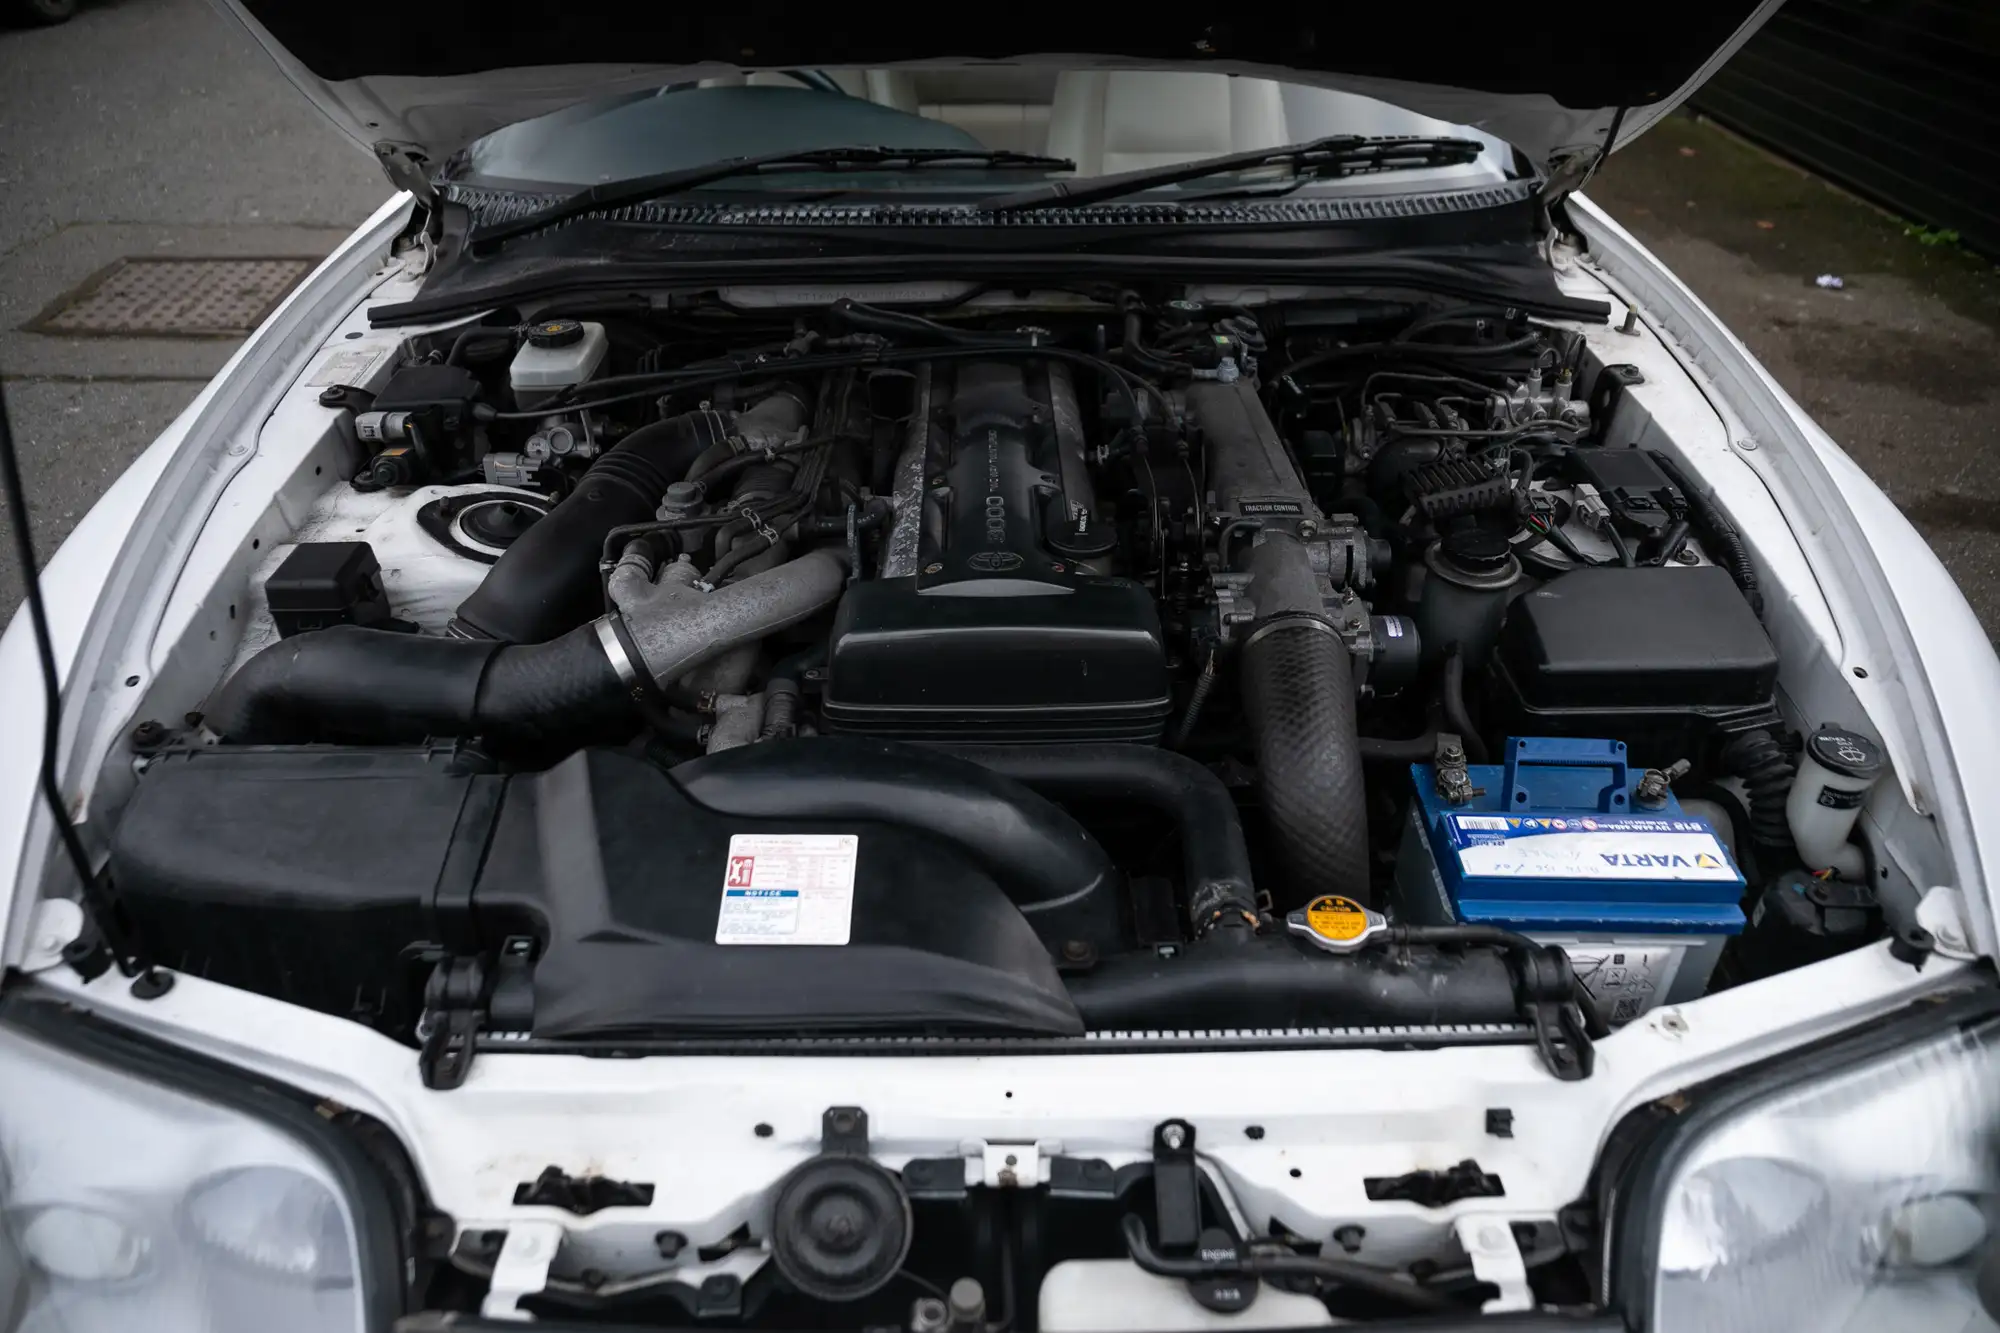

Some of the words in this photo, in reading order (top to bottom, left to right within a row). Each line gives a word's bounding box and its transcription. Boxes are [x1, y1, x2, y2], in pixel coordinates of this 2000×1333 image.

[1244, 504, 1272, 512] TRACTION
[1273, 504, 1300, 512] CONTROL
[985, 496, 1006, 543] 3000
[1599, 853, 1692, 868] VARTA
